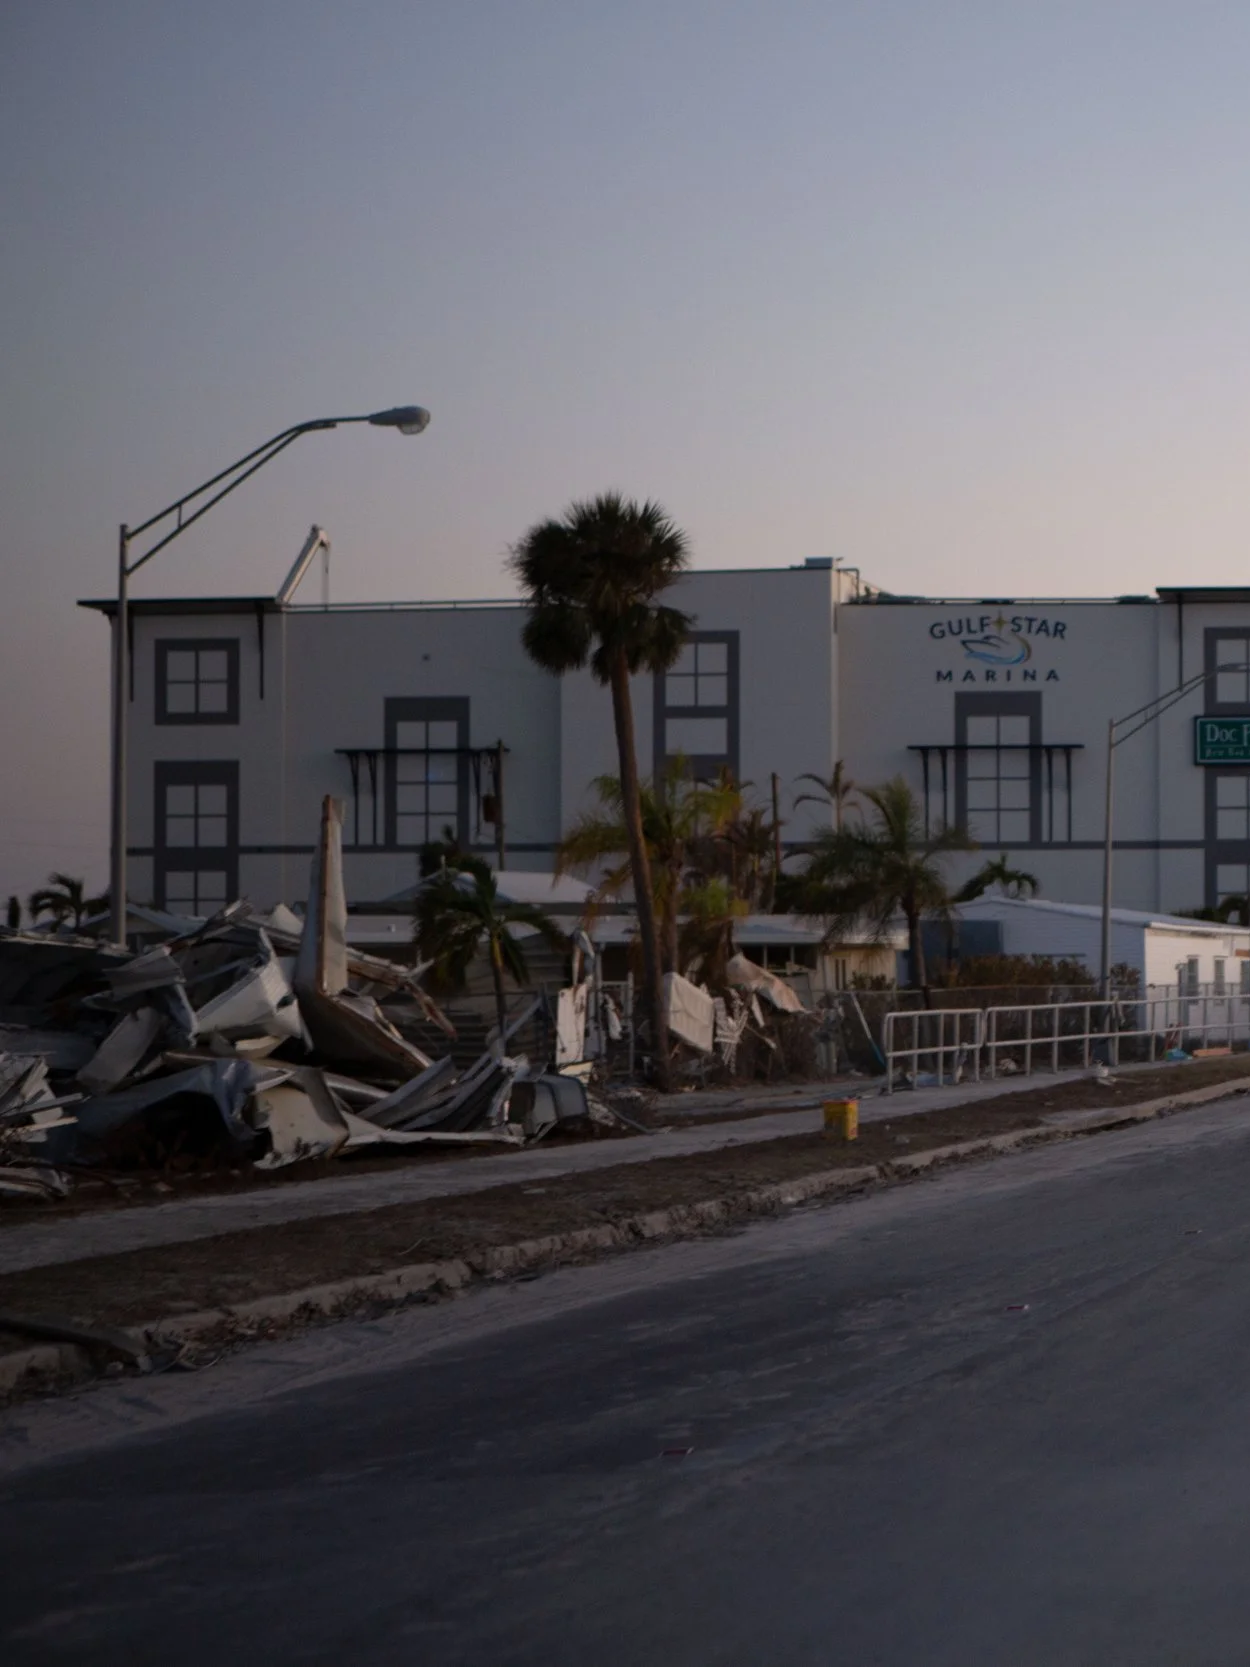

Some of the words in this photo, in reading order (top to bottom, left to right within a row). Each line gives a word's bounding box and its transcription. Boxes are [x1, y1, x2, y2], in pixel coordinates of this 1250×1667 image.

[930, 616, 991, 639] GULF
[1011, 616, 1067, 639] STAR
[936, 669, 1060, 682] MARINA
